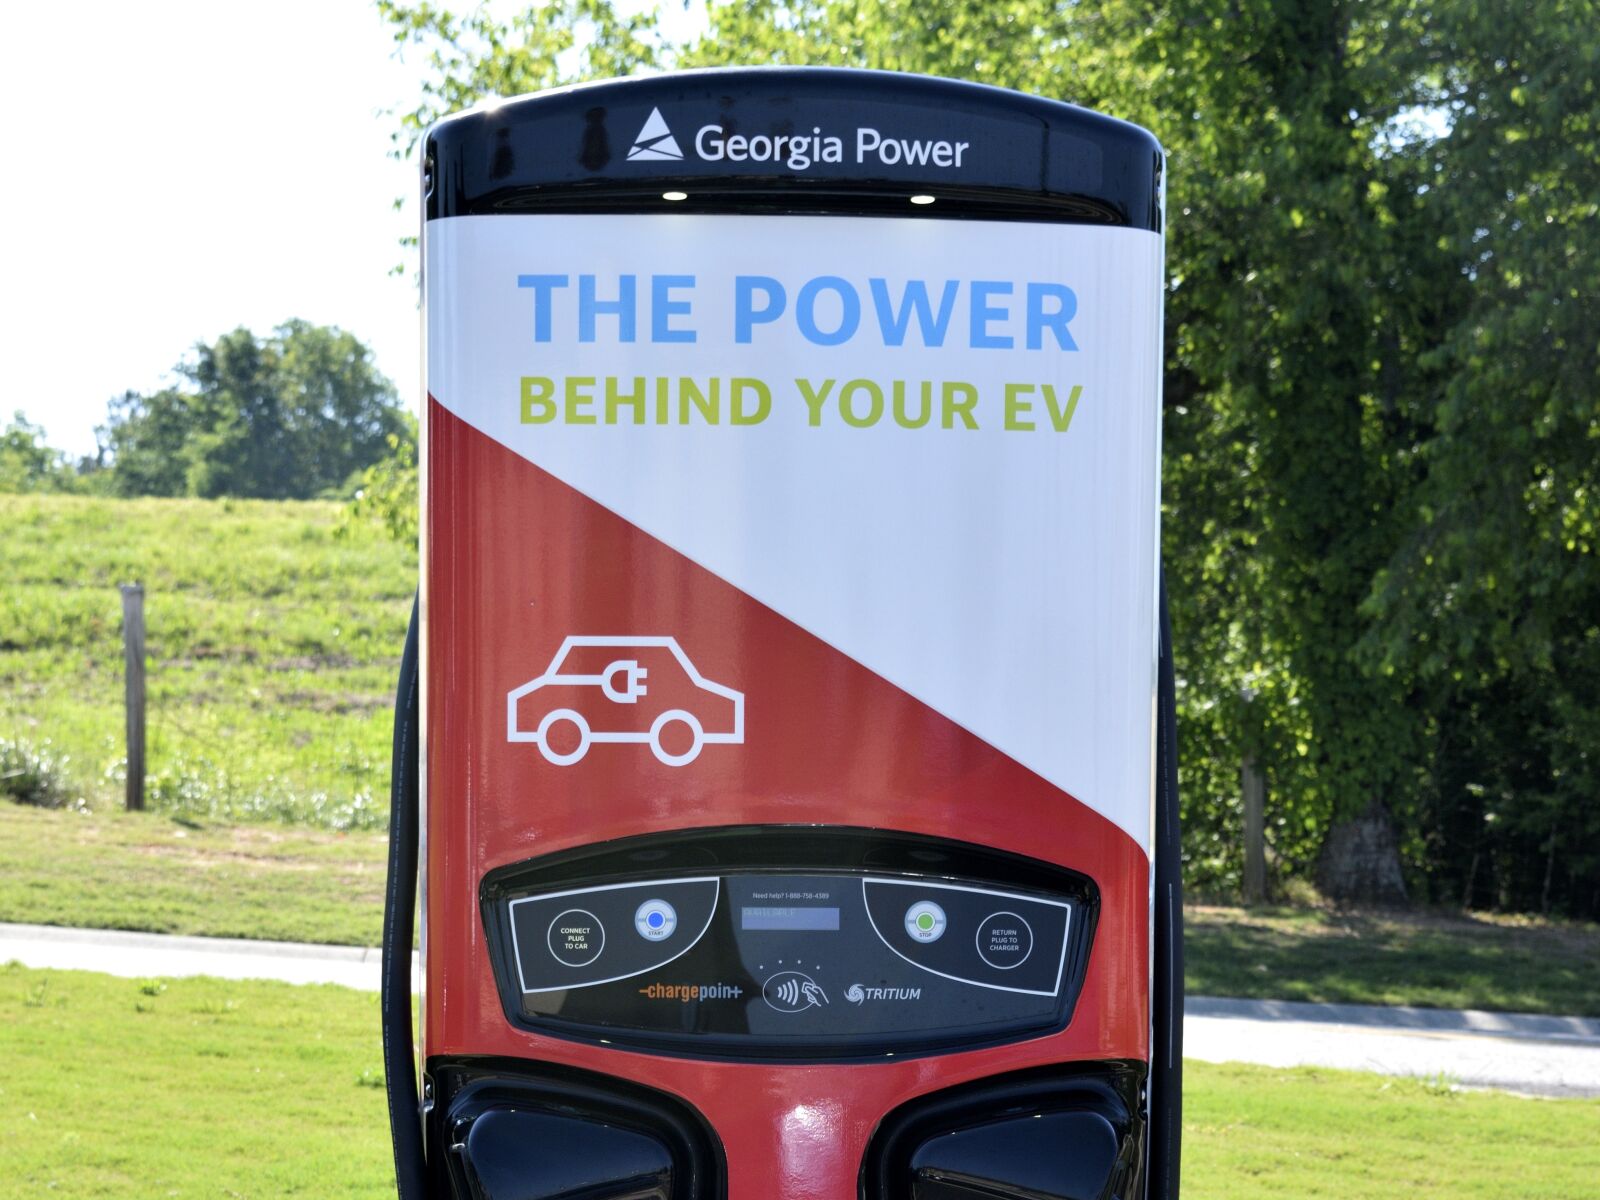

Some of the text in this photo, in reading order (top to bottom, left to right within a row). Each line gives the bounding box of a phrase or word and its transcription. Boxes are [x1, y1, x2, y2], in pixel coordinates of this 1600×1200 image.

[695, 124, 969, 170] Georgia Power
[517, 273, 1079, 351] THE POWER
[519, 376, 1083, 432] BEHIND YOUR EV
[768, 892, 784, 900] help?
[865, 988, 921, 1000] TRITIUM
